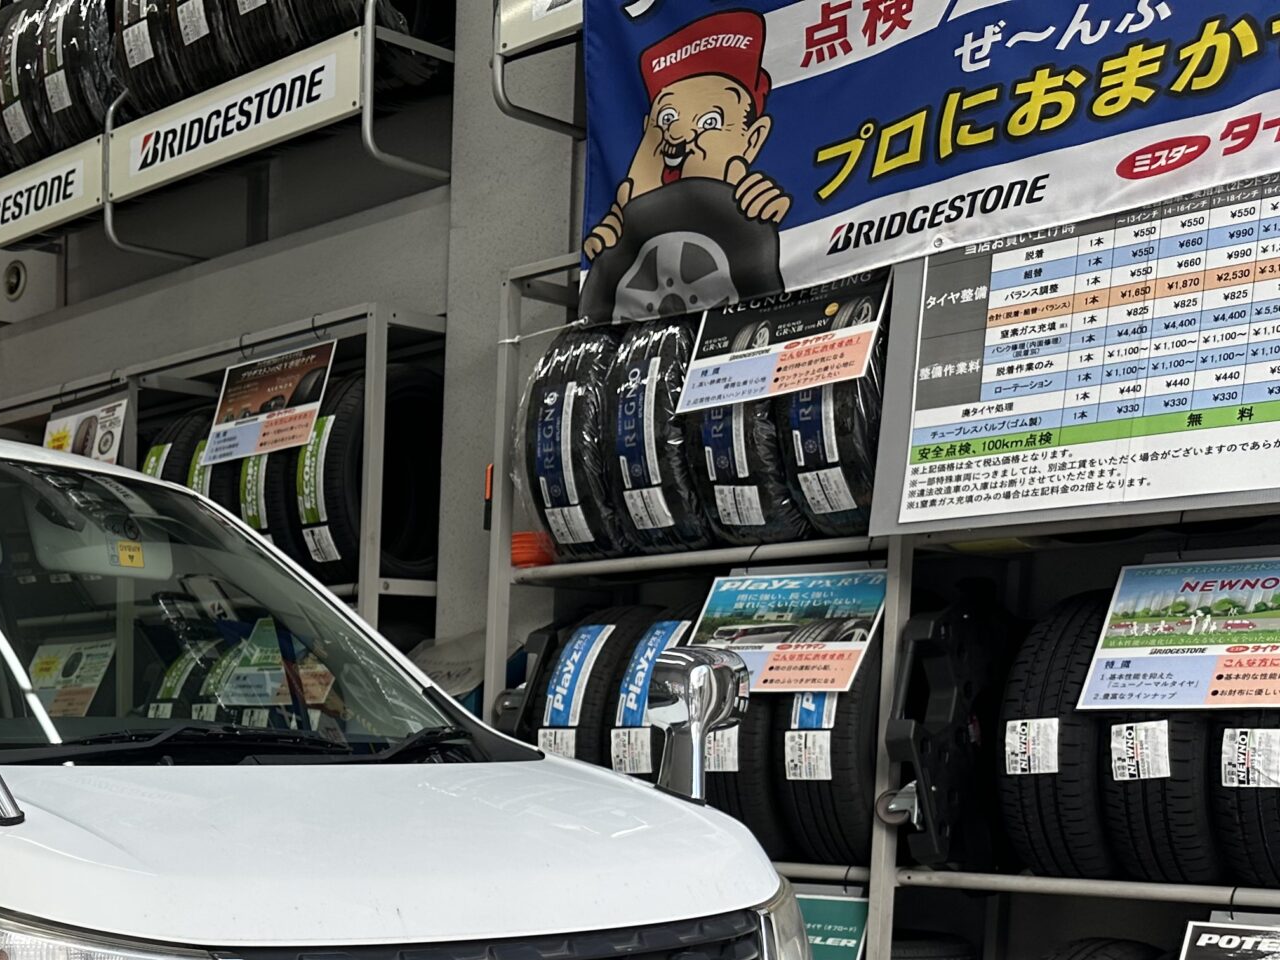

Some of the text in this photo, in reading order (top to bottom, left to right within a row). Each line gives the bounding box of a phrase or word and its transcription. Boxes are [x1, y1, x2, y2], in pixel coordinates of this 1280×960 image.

[799, 0, 915, 68] 点検
[651, 33, 753, 74] BRIDGESTONE
[138, 65, 326, 171] BRIDGESTONE
[816, 18, 1280, 200] プロにおまか
[1132, 144, 1199, 173] ミスター
[826, 173, 1050, 257] BRIDGESTONE
[1025, 248, 1044, 261] 脱着
[1133, 226, 1157, 238] ¥550
[1180, 216, 1205, 228] ¥550
[1230, 206, 1256, 218] ¥550
[1131, 246, 1155, 258] ¥550
[1178, 237, 1203, 249] ¥660
[1228, 227, 1254, 239] ¥990
[1004, 283, 1059, 301] バランス調整
[1130, 266, 1153, 278] ¥550
[1177, 257, 1201, 269] ¥660
[1226, 247, 1252, 260] ¥990
[1120, 285, 1151, 299] ¥1,650
[1167, 277, 1200, 291] ¥1,870
[1216, 268, 1250, 282] ¥2,530
[926, 285, 988, 309] タイヤ整備
[1126, 305, 1149, 317] ¥825
[1173, 298, 1198, 309] ¥825
[1223, 289, 1248, 301] ¥825
[1117, 325, 1148, 338] ¥4,400
[1164, 318, 1196, 331] ¥4,400
[1213, 309, 1247, 322] ¥4,400
[919, 358, 981, 381] 整備作業料
[996, 360, 1054, 377] 脱着作業のみ
[961, 402, 1014, 418] 廃タイヤ処理
[1119, 384, 1142, 395] ¥440
[1165, 377, 1190, 388] ¥440
[1214, 370, 1240, 382] ¥440
[994, 379, 1053, 394] ローテーション
[624, 367, 641, 448] REGNO
[1117, 403, 1140, 414] ¥330
[1163, 397, 1188, 408] ¥330
[1212, 391, 1238, 402] ¥330
[918, 431, 1053, 460] 安全点検、100km点検
[1180, 576, 1280, 593] NEWNO
[1149, 647, 1208, 655] BRIDGESTONE
[1019, 725, 1028, 769] NEWNO
[1125, 728, 1136, 773] NEWNO
[1236, 734, 1248, 780] NEWNO
